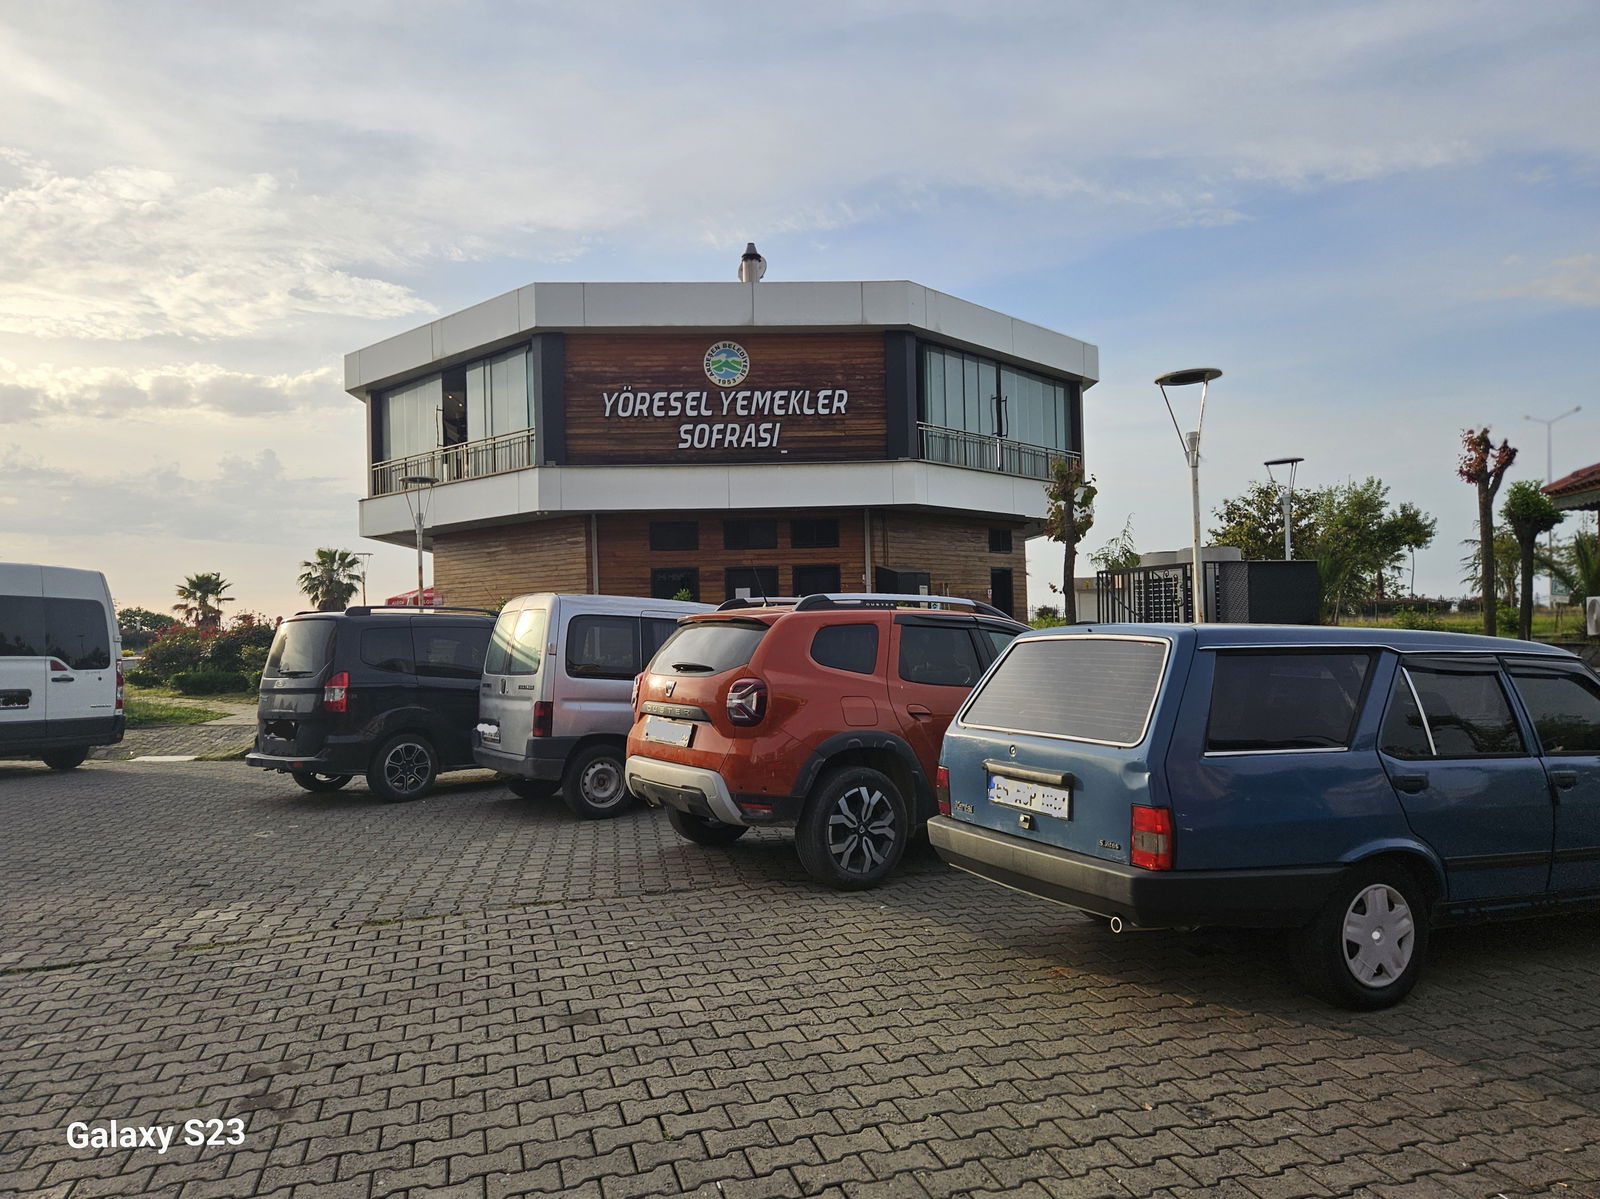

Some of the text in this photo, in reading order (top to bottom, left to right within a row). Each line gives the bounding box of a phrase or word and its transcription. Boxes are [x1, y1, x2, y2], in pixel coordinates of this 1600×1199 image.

[705, 344, 720, 377] ARDEŞEN
[602, 386, 849, 417] YÖRESEL YEMEKLER
[678, 422, 782, 449] SOFRASI
[646, 704, 691, 717] DUSTER
